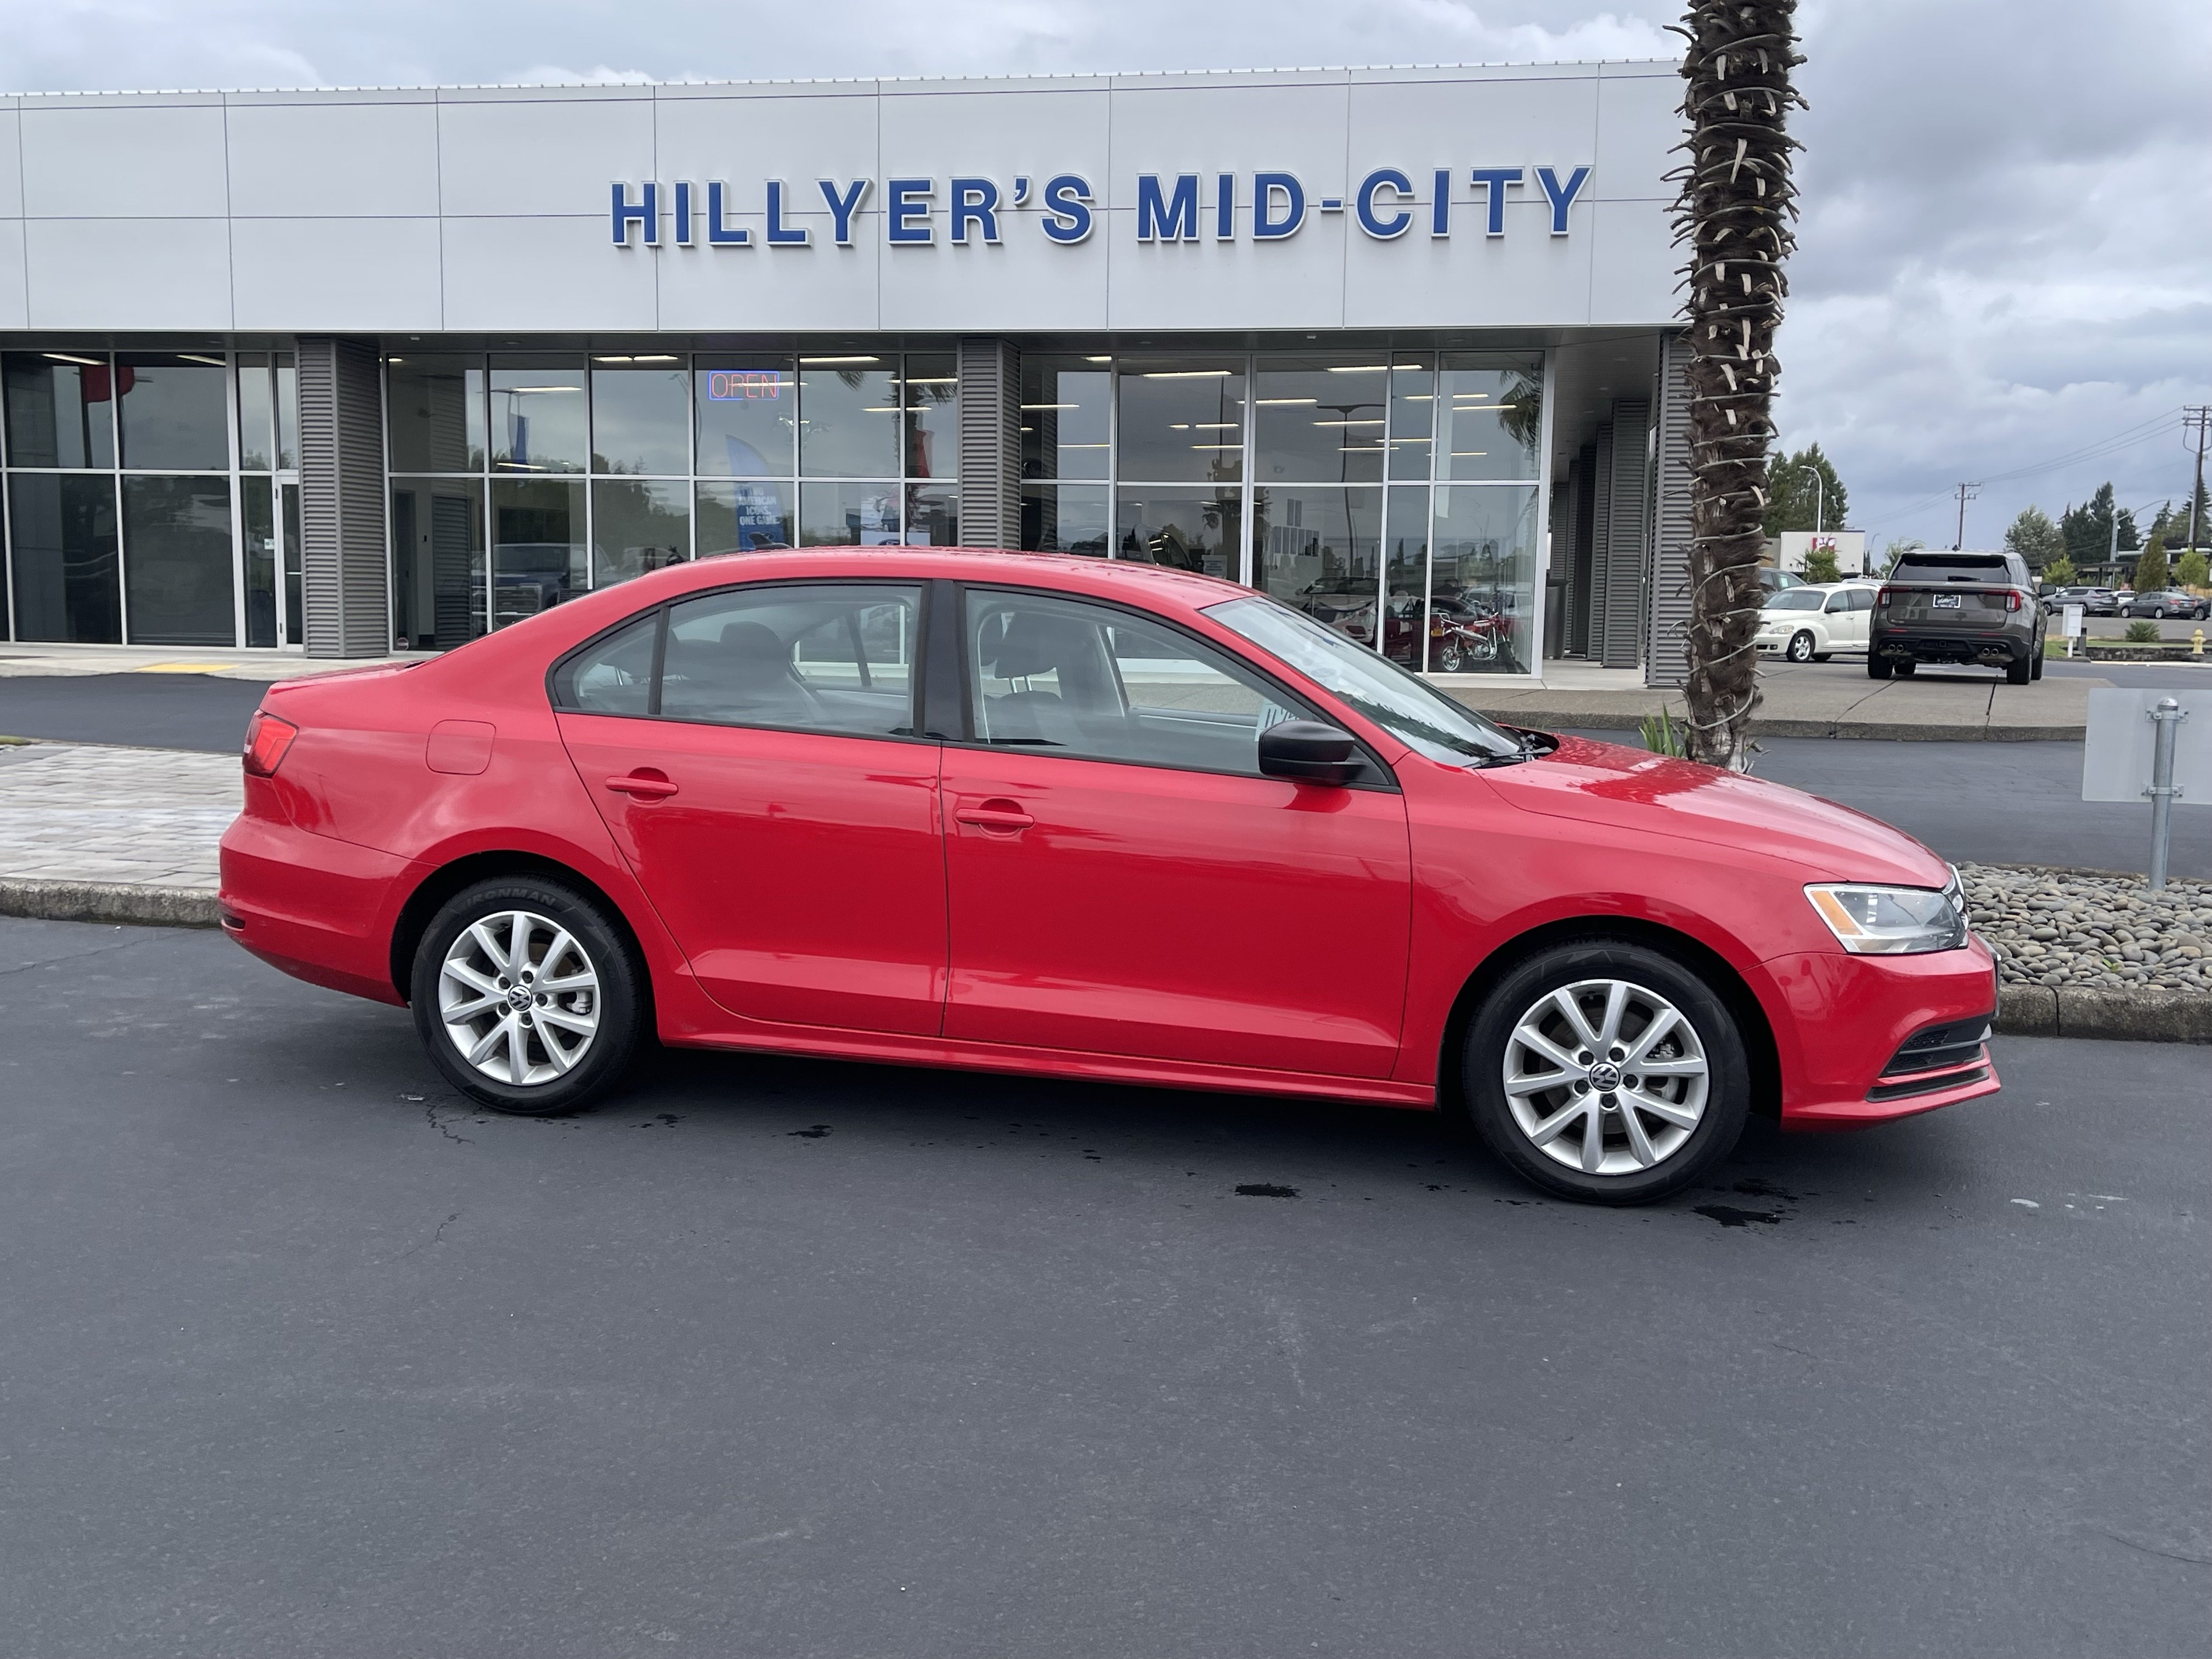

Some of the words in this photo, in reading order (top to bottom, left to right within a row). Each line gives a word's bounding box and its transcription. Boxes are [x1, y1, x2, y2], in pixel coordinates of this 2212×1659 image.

[610, 173, 1094, 247] HILLYER'S
[1136, 166, 1594, 242] MID-CITY
[712, 374, 777, 398] OPEN
[740, 516, 755, 526] ONE
[466, 888, 556, 906] IRONMAN
